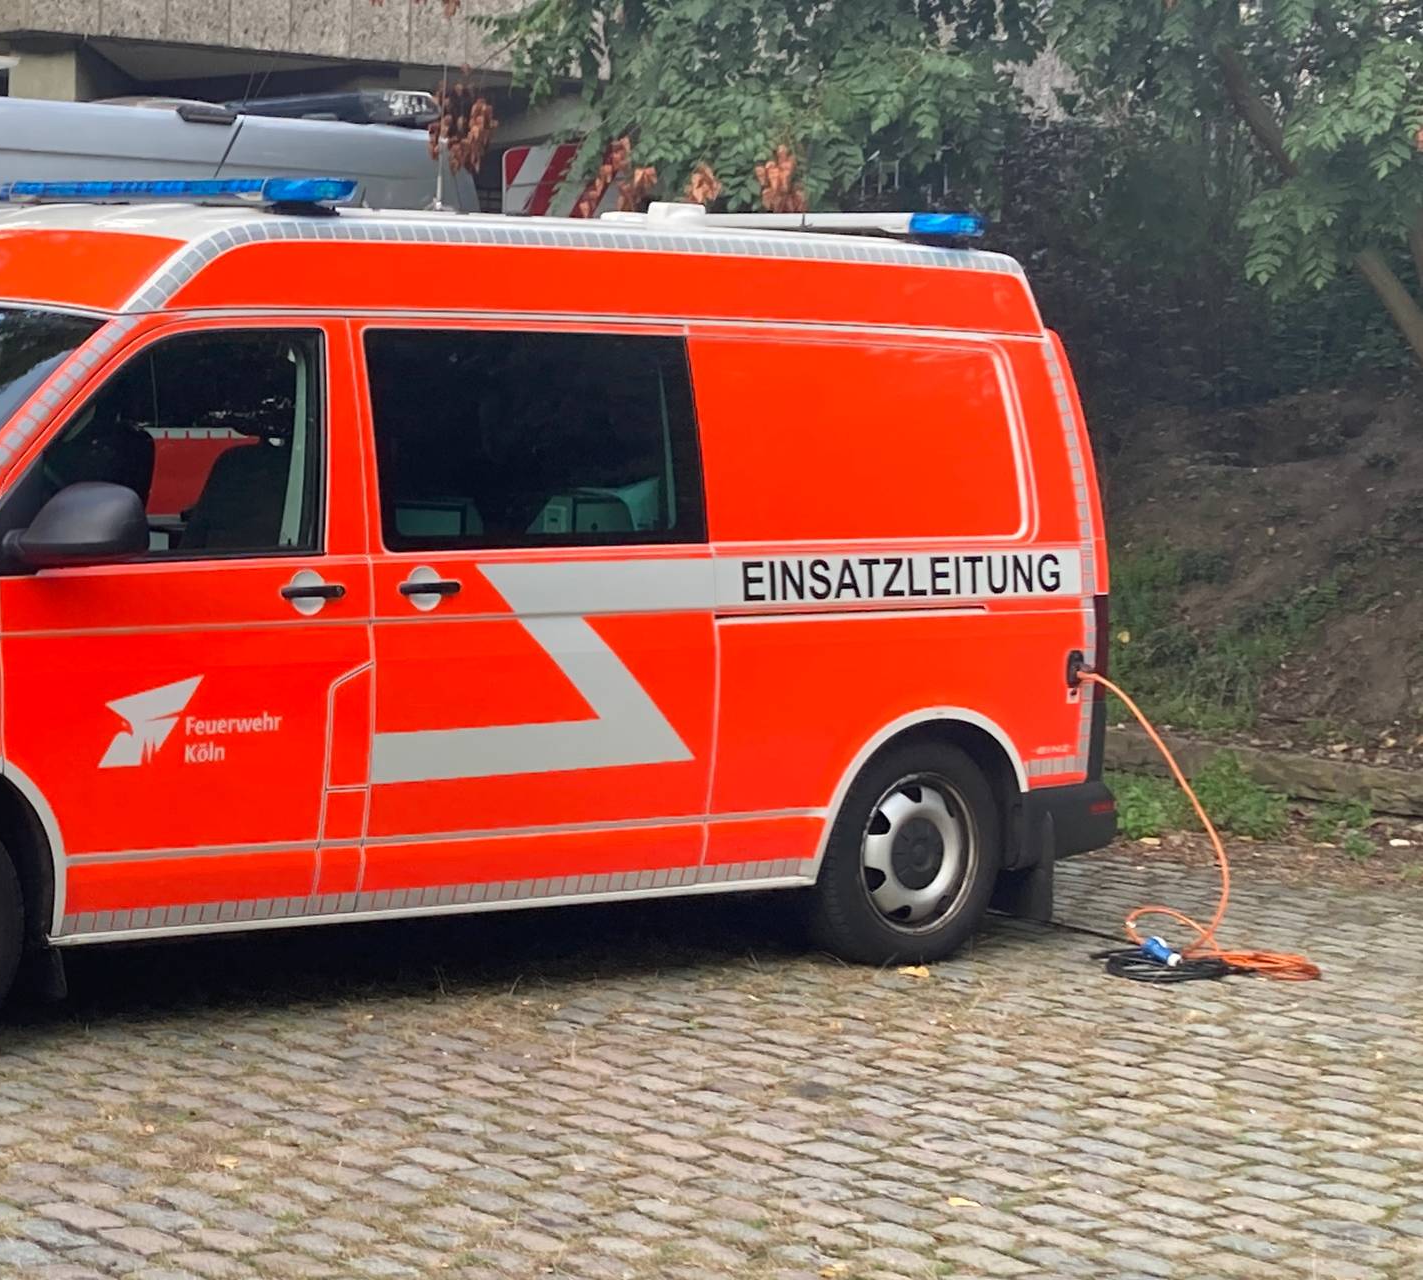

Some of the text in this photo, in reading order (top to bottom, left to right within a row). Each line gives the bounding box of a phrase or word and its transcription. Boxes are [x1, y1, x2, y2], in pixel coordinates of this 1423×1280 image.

[742, 553, 1062, 602] EINSATZLEITUNG
[185, 711, 283, 736] Feuerwehr
[184, 741, 226, 763] Köln
